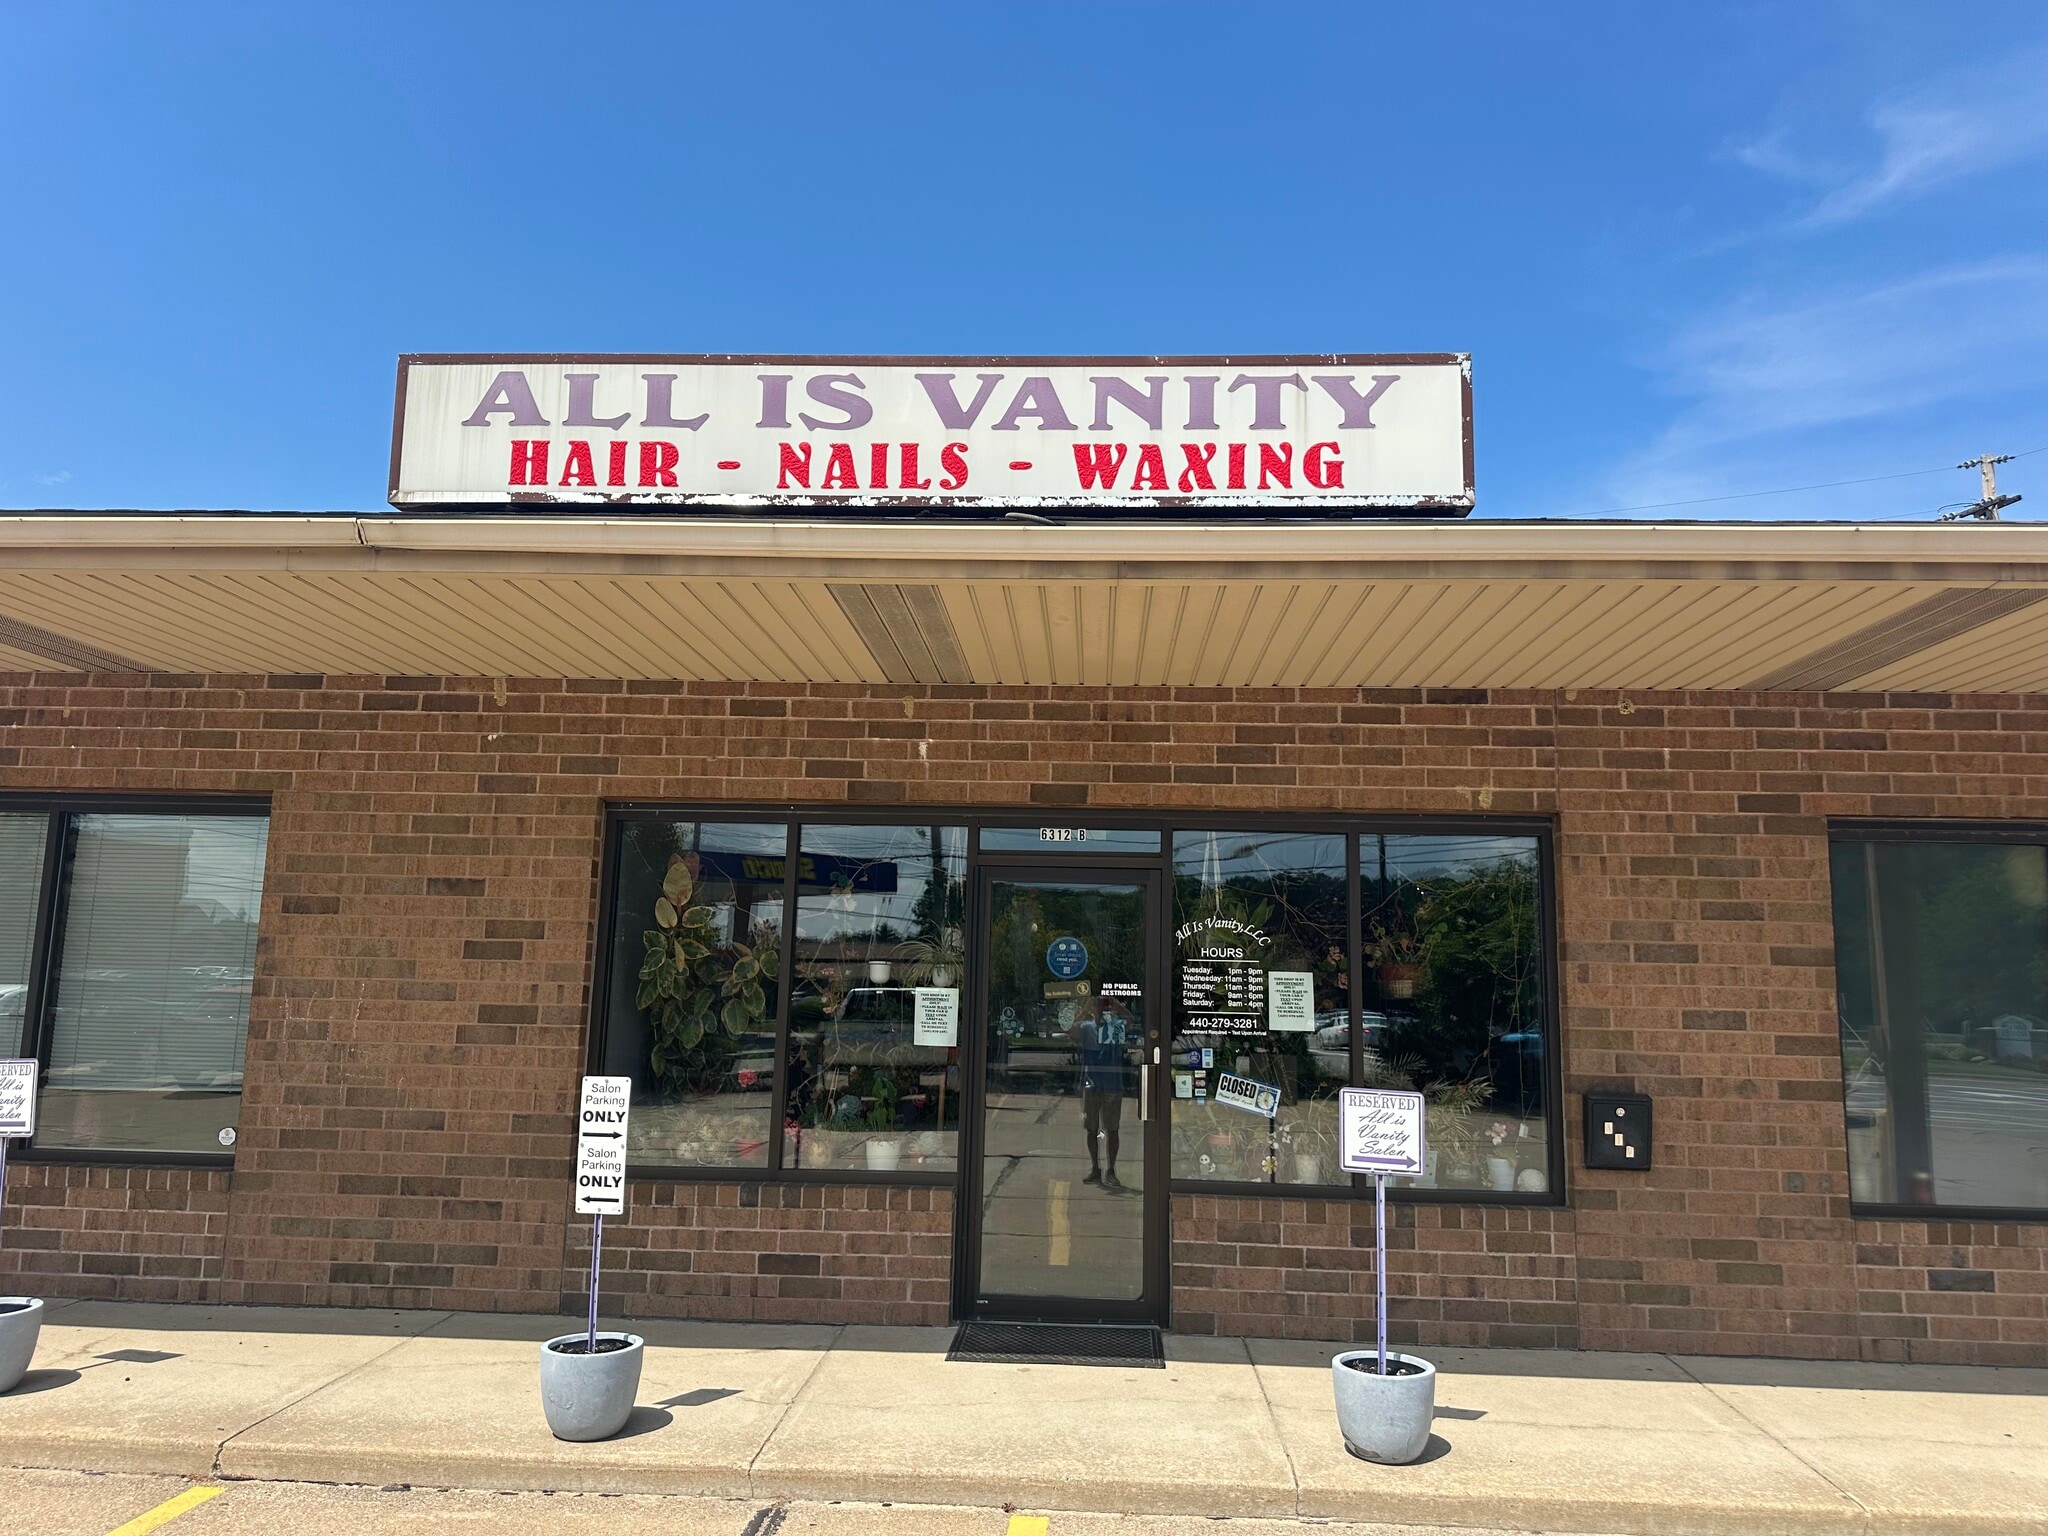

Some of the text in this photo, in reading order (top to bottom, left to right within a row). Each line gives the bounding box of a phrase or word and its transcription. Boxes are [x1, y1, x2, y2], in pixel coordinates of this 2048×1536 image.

[462, 371, 1400, 432] ALL IS VANITY
[509, 440, 679, 488] HAIR
[777, 442, 968, 490] NAILS
[1072, 442, 1345, 492] WAXING
[1041, 829, 1086, 840] 6312 B
[1175, 922, 1192, 945] All
[1192, 921, 1203, 933] Is
[1244, 924, 1271, 946] LLC
[1201, 948, 1243, 958] HOURS
[1182, 966, 1213, 975] Tuesday:
[1182, 974, 1223, 983] Wednesday:
[1248, 976, 1263, 984] 9pm
[1182, 982, 1215, 991] Thursday:
[1248, 984, 1263, 992] 9pm
[1182, 991, 1205, 999] Friday:
[1248, 992, 1263, 1000] 6pm
[1182, 999, 1214, 1007] Saturday:
[1190, 1018, 1257, 1028] 440-279-3281
[591, 1083, 621, 1093] Salon
[1220, 1076, 1256, 1098] CLOSED
[585, 1095, 625, 1107] Parking
[1348, 1095, 1416, 1111] RESERVED
[583, 1110, 626, 1123] ONLY
[1358, 1109, 1406, 1125] All is
[1358, 1124, 1410, 1146] Vanity
[587, 1148, 616, 1158] Salon
[1359, 1140, 1406, 1156] Salon
[581, 1160, 621, 1172] Parking
[579, 1175, 622, 1188] ONLY
